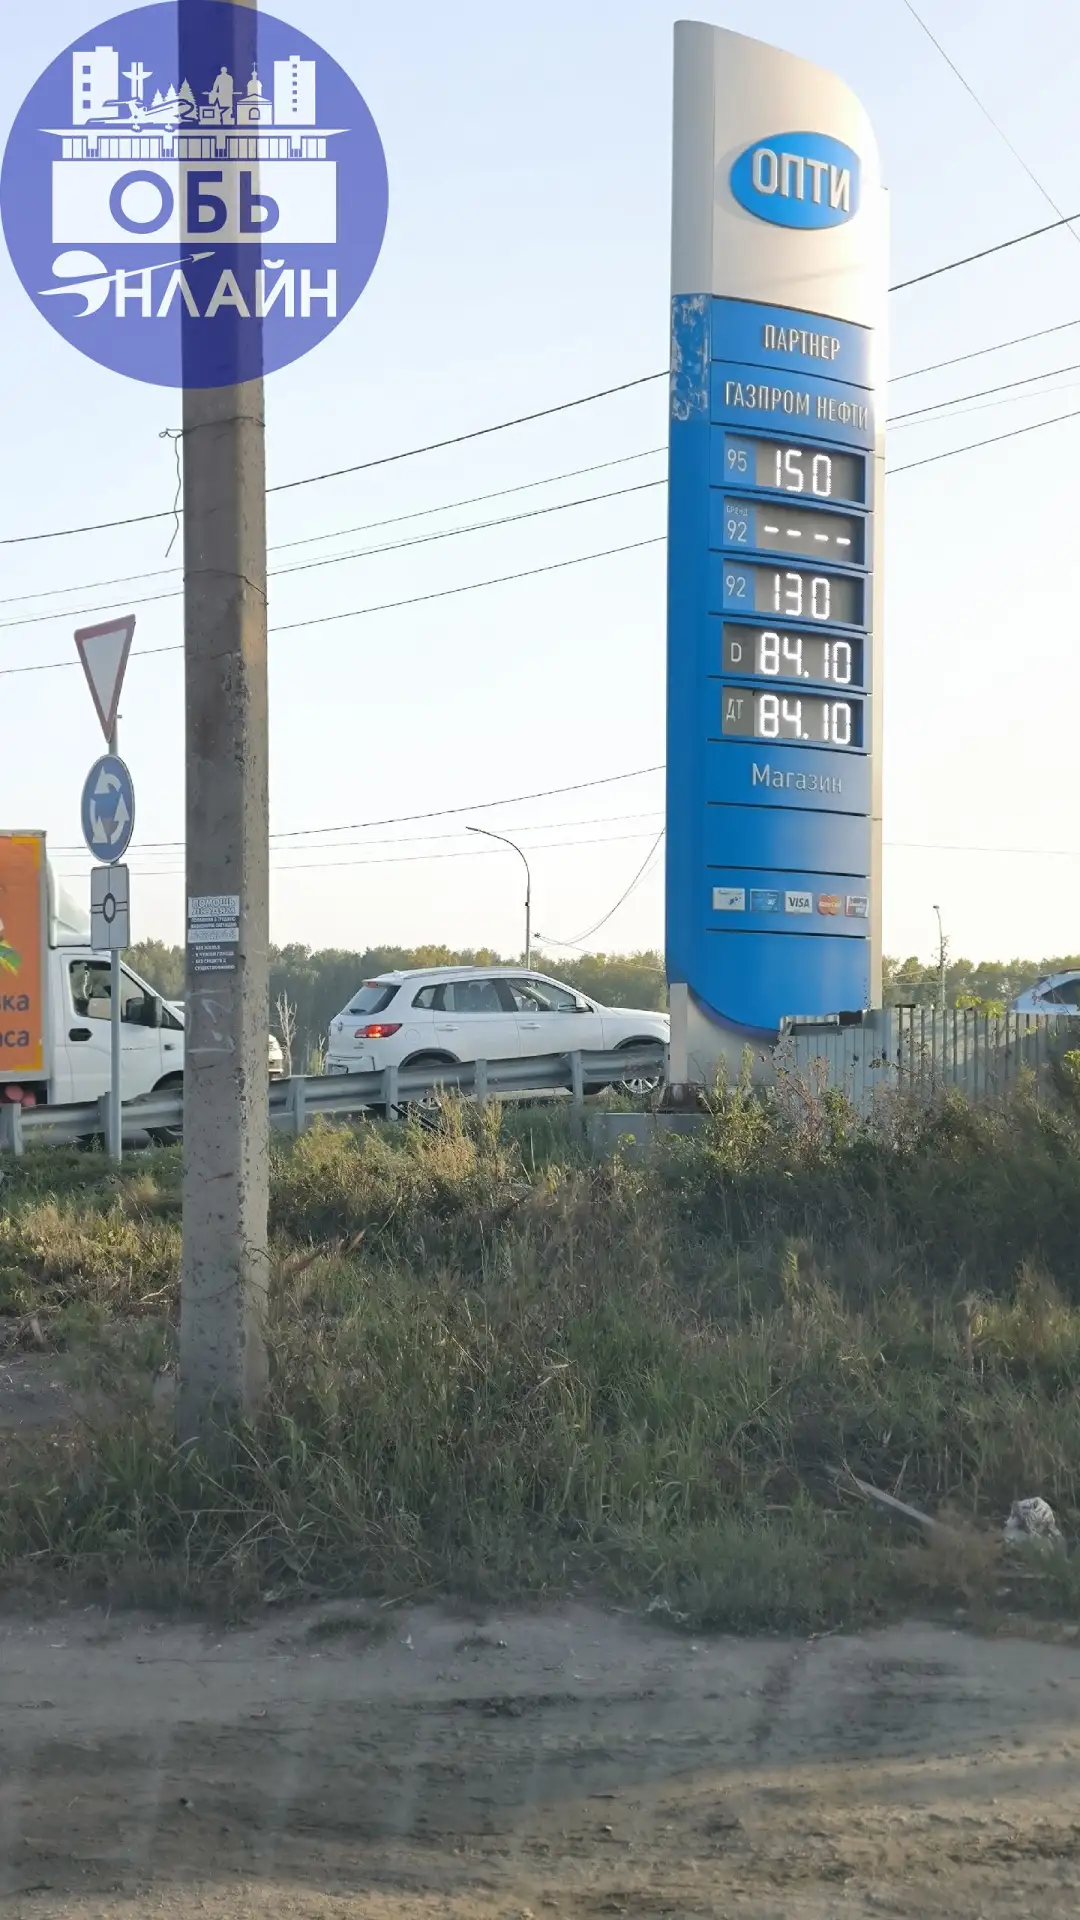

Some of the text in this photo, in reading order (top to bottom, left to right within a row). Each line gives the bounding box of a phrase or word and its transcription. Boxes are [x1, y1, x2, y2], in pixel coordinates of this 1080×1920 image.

[752, 148, 850, 213] ОПТИ
[763, 324, 841, 360] ПАРТНЕР
[725, 381, 869, 431] ГАЗПРОМ НЕФТИ
[727, 449, 832, 497] 95 150
[727, 519, 747, 543] 92
[725, 572, 830, 620] 92 130
[730, 632, 851, 684] D 84.10
[726, 694, 851, 745] ДТ 84.10
[752, 762, 842, 793] Магазин
[788, 896, 810, 908] VISA
[0, 994, 30, 1012] ка
